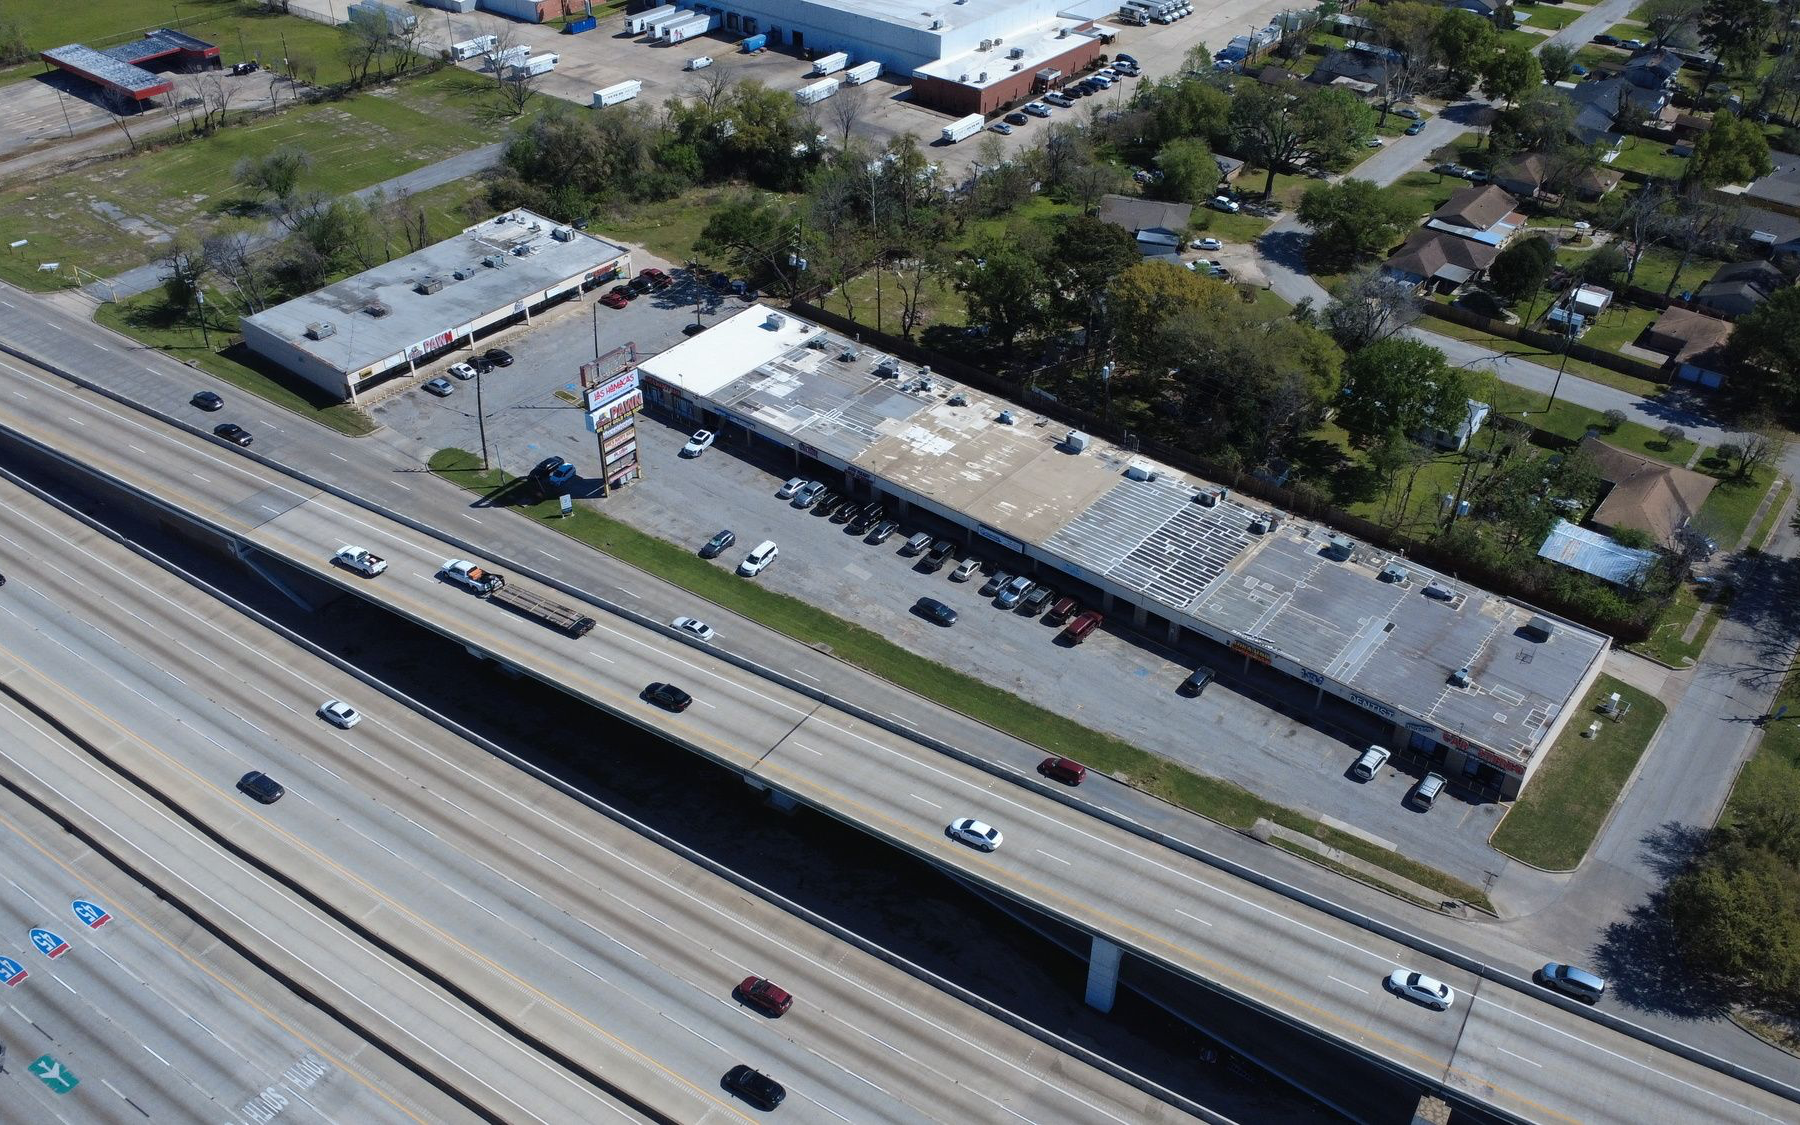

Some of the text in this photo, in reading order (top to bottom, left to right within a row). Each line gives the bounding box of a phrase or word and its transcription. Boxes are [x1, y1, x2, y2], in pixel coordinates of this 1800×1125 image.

[423, 330, 453, 353] PAWN
[594, 389, 605, 402] LAS
[606, 373, 634, 395] HAMACAS
[610, 393, 642, 420] PAWN
[1349, 693, 1395, 719] DENTIST
[1442, 732, 1469, 751] CAR
[75, 903, 99, 922] 45
[33, 932, 57, 951] 45
[283, 1053, 328, 1090] SOUTH
[241, 1086, 289, 1125] SOUTH
